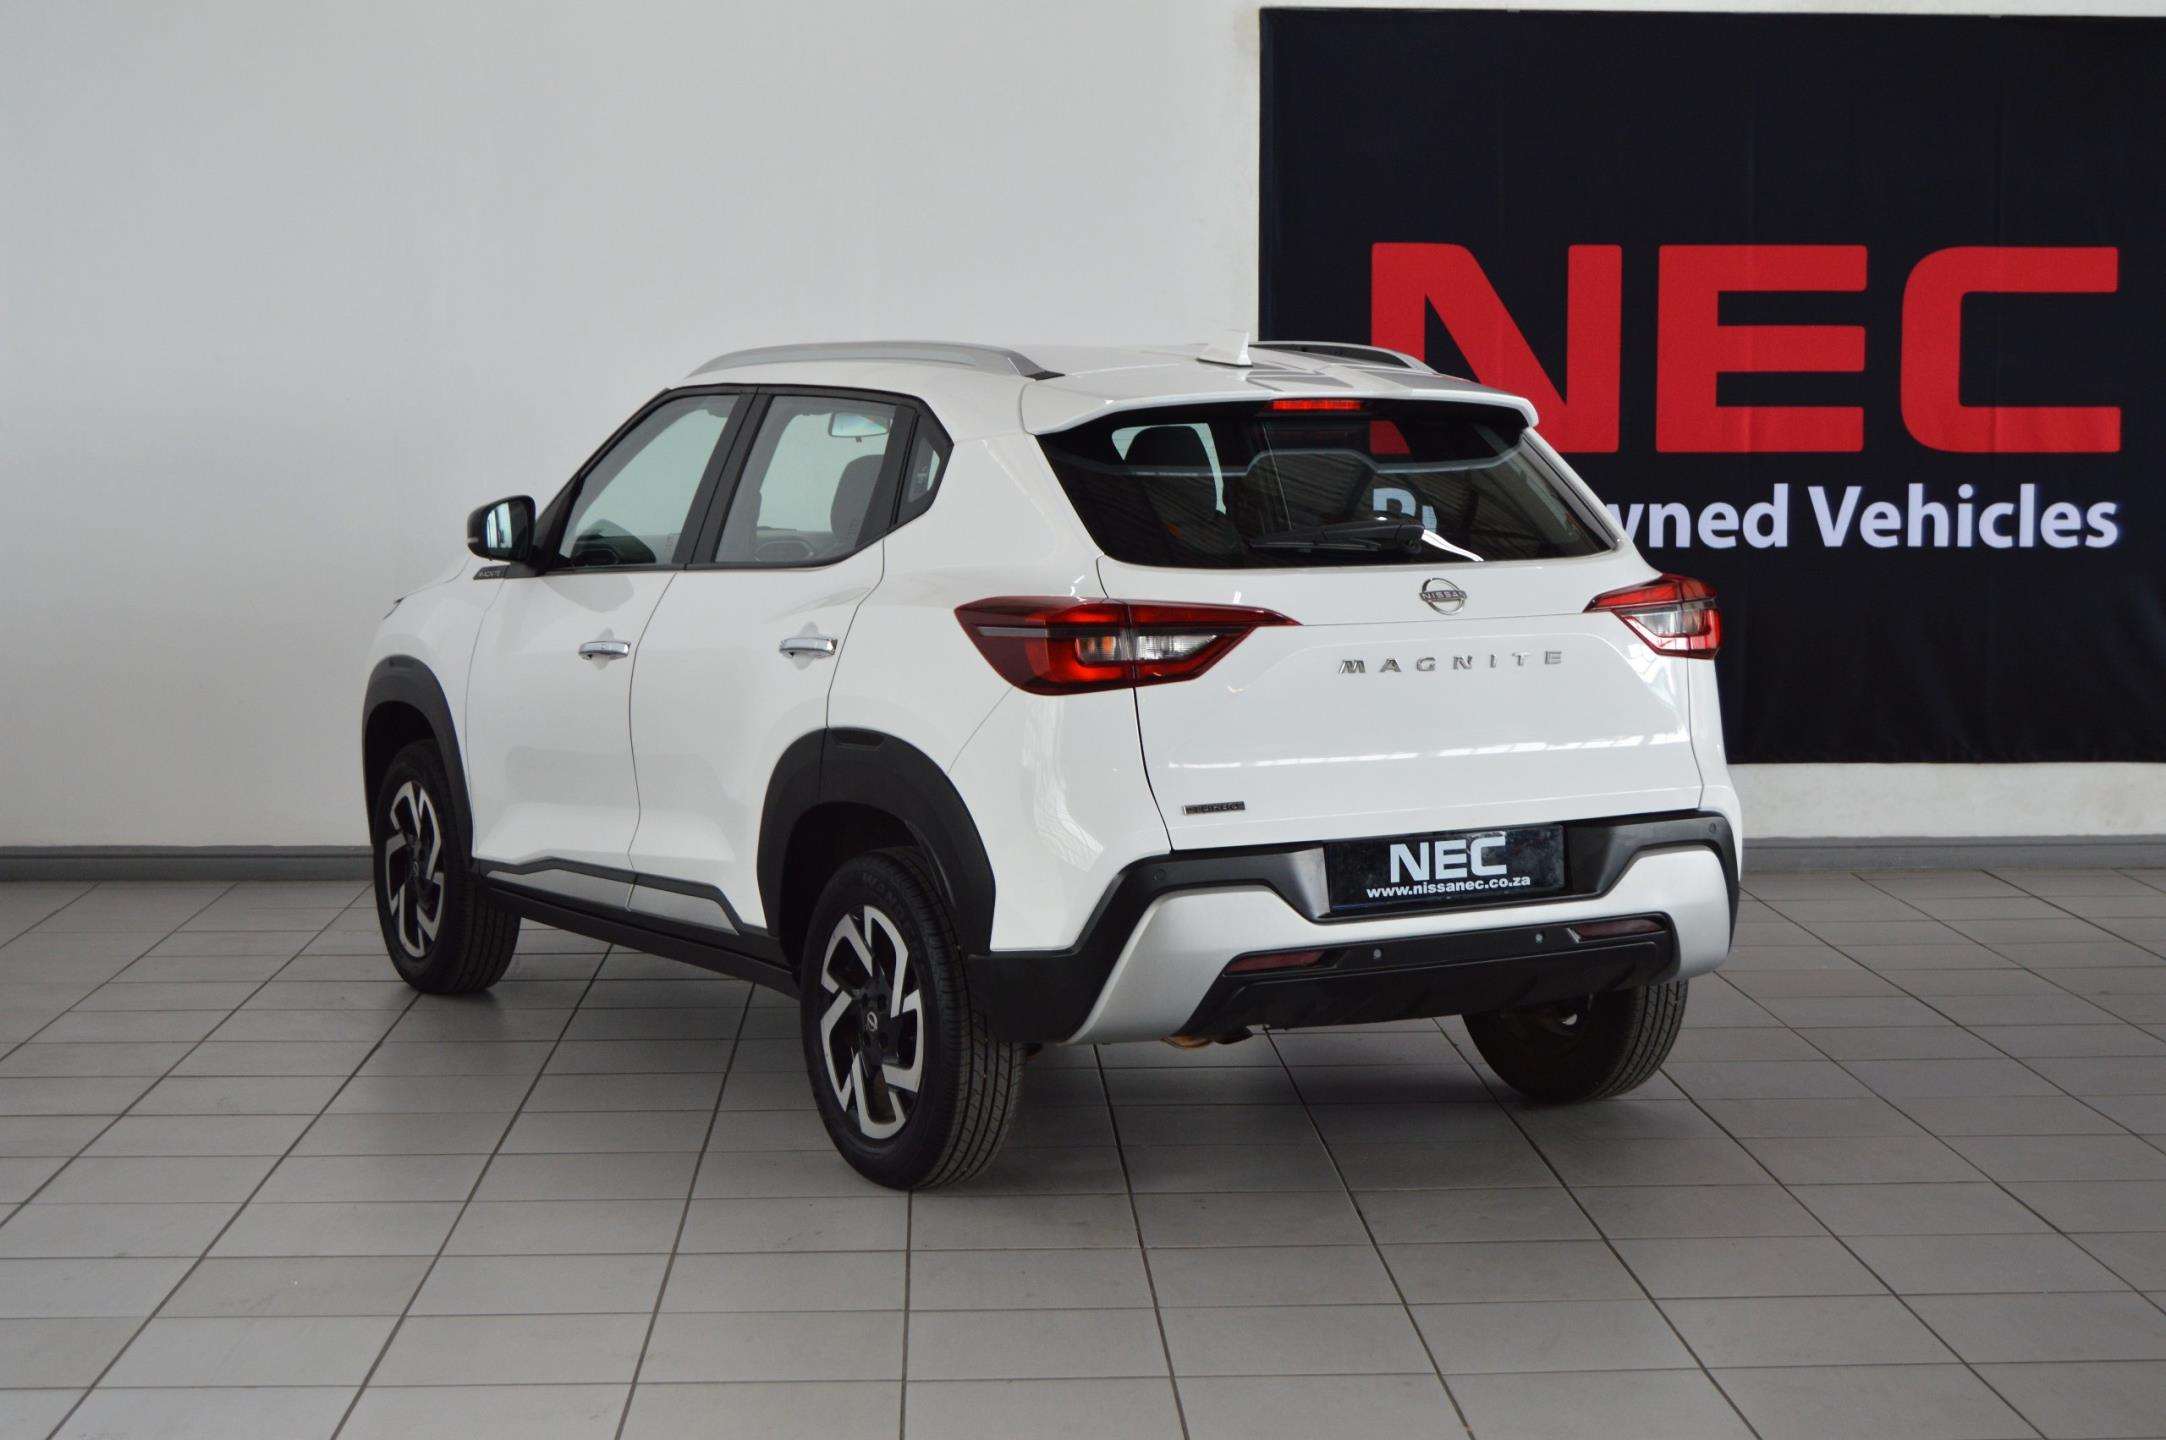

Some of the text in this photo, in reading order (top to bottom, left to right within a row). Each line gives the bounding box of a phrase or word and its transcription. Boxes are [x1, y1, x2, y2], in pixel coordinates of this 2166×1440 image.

[1371, 242, 2122, 453] NEC
[1808, 483, 2119, 549] Vehicles
[1338, 650, 1562, 675] MAGNITE
[1389, 835, 1508, 883] NEC
[1366, 875, 1531, 898] www.nissanec.co.za
